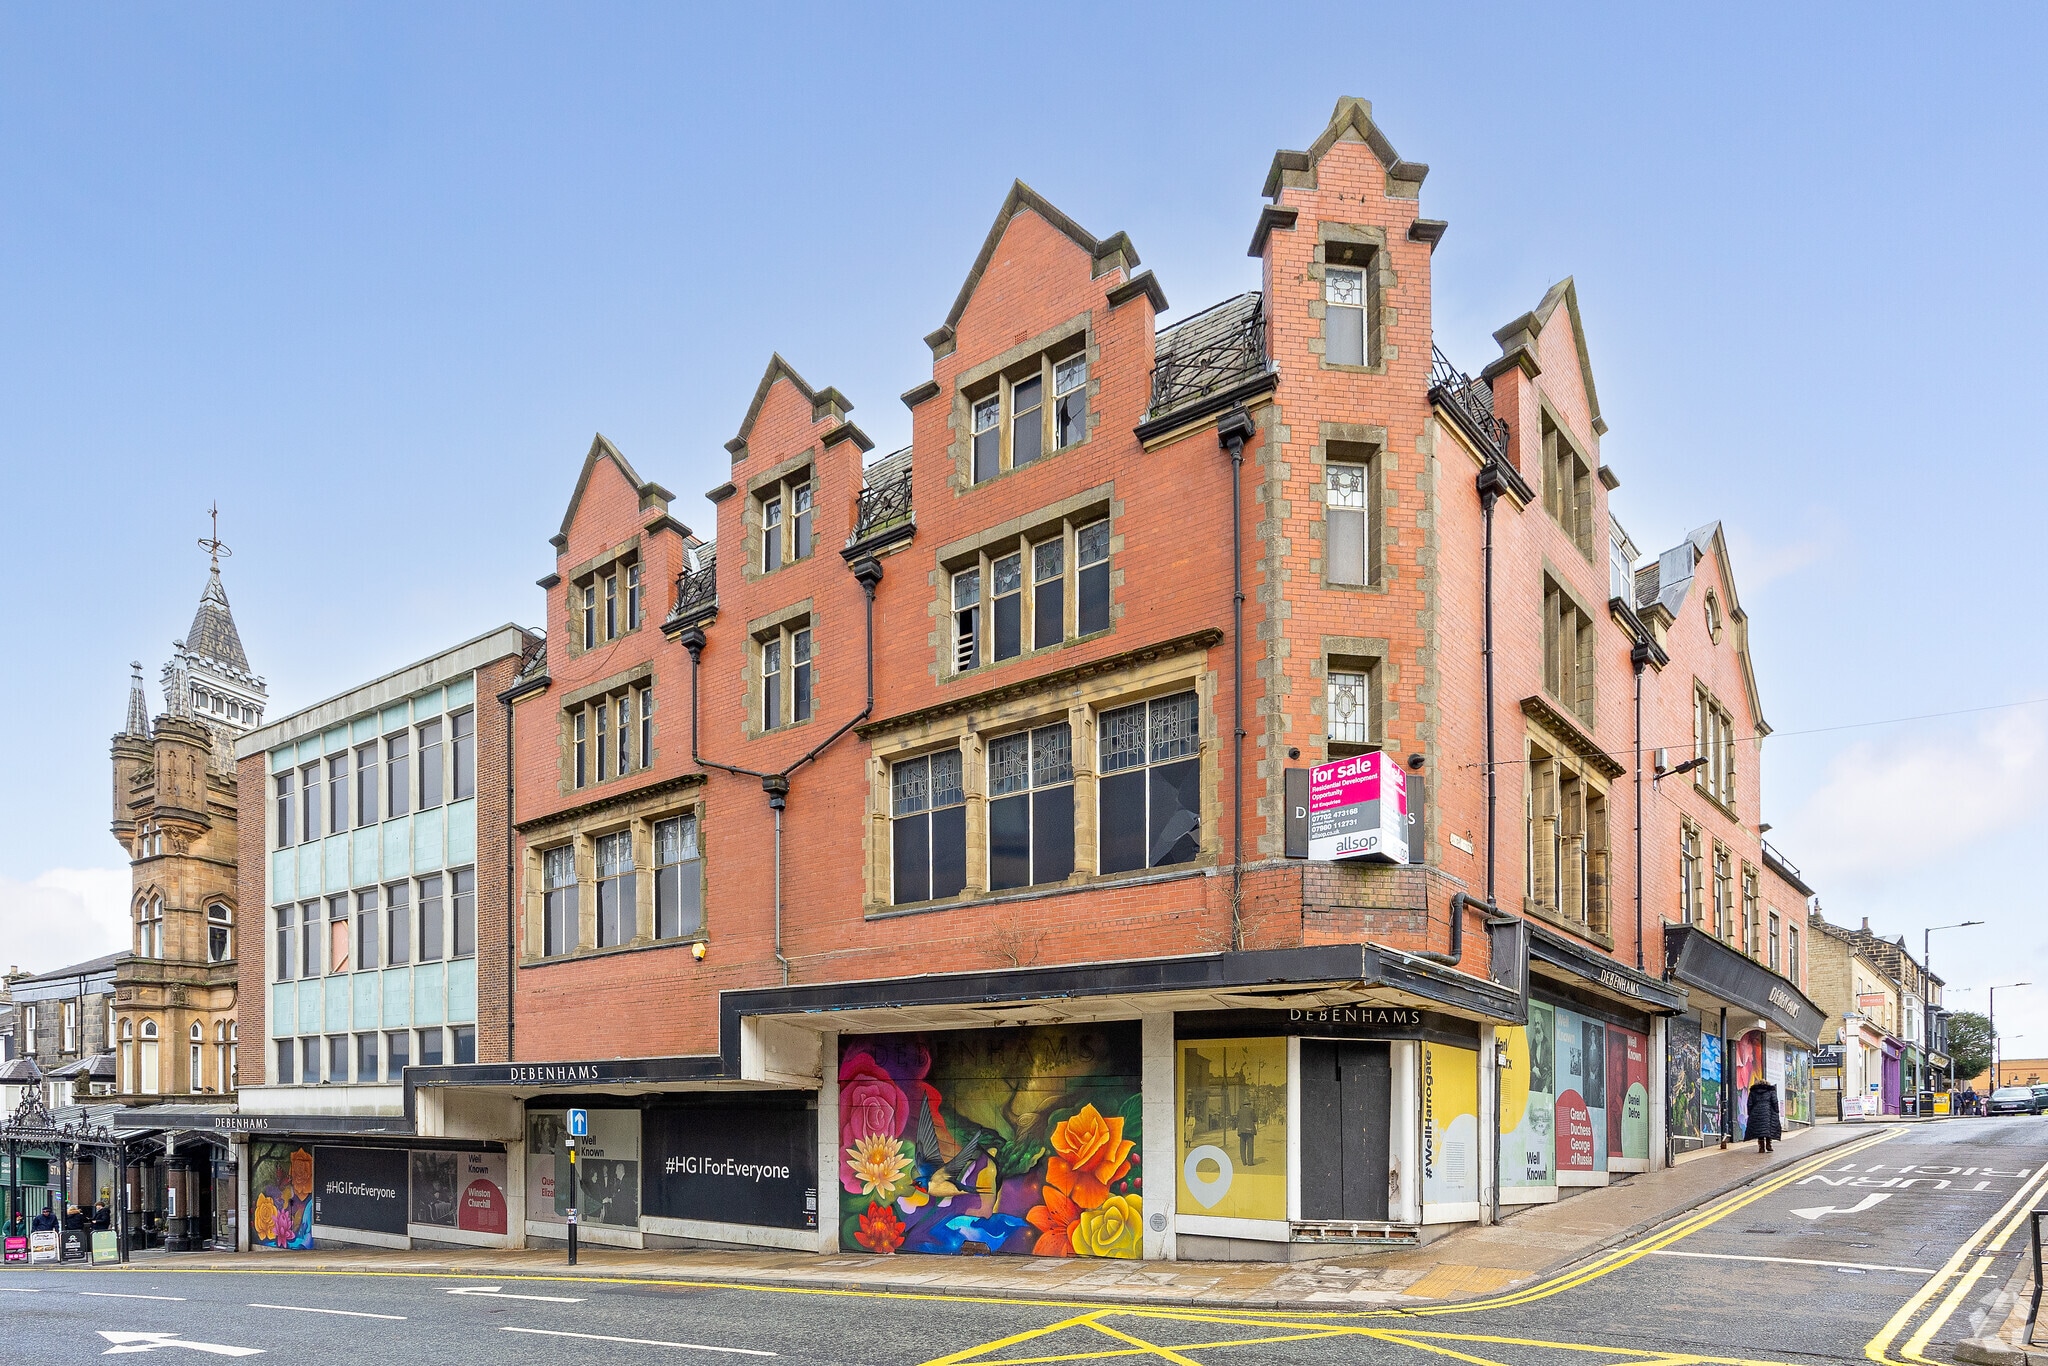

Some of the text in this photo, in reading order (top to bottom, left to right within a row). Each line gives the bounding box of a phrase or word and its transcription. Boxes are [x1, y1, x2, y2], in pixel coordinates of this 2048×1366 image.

[1312, 758, 1371, 784] for sale
[1312, 773, 1378, 792] Residential Development
[1312, 789, 1343, 801] Opportunity
[1319, 799, 1341, 808] Enquiries
[1336, 836, 1378, 851] allsop
[1600, 969, 1640, 996] DEBENHAMS
[1290, 1008, 1420, 1024] DEBENHAMS
[1556, 1013, 1569, 1027] Well
[1556, 1031, 1575, 1045] Known
[1628, 1034, 1637, 1048] Well
[1628, 1048, 1642, 1062] Known
[510, 1065, 599, 1081] DEBENHAMS
[1629, 1094, 1640, 1106] Daniel
[1425, 1050, 1433, 1180] #WellHarrogate
[1570, 1108, 1586, 1121] Grand
[215, 1117, 268, 1129] DEBENHAMS
[1570, 1123, 1591, 1136] Duchess
[581, 1135, 596, 1145] Well
[1570, 1138, 1590, 1153] George
[469, 1154, 481, 1163] Well
[581, 1147, 604, 1157] Known
[1526, 1152, 1540, 1165] Well
[1570, 1152, 1592, 1166] of Russia
[469, 1164, 488, 1174] Known
[1526, 1167, 1547, 1181] Known
[1819, 1163, 2032, 1178] RIGHT
[542, 1176, 555, 1186] Que
[1795, 1175, 2002, 1193] TURN
[468, 1187, 490, 1198] Winston
[542, 1188, 555, 1198] Eliza
[468, 1198, 490, 1209] Churchill
